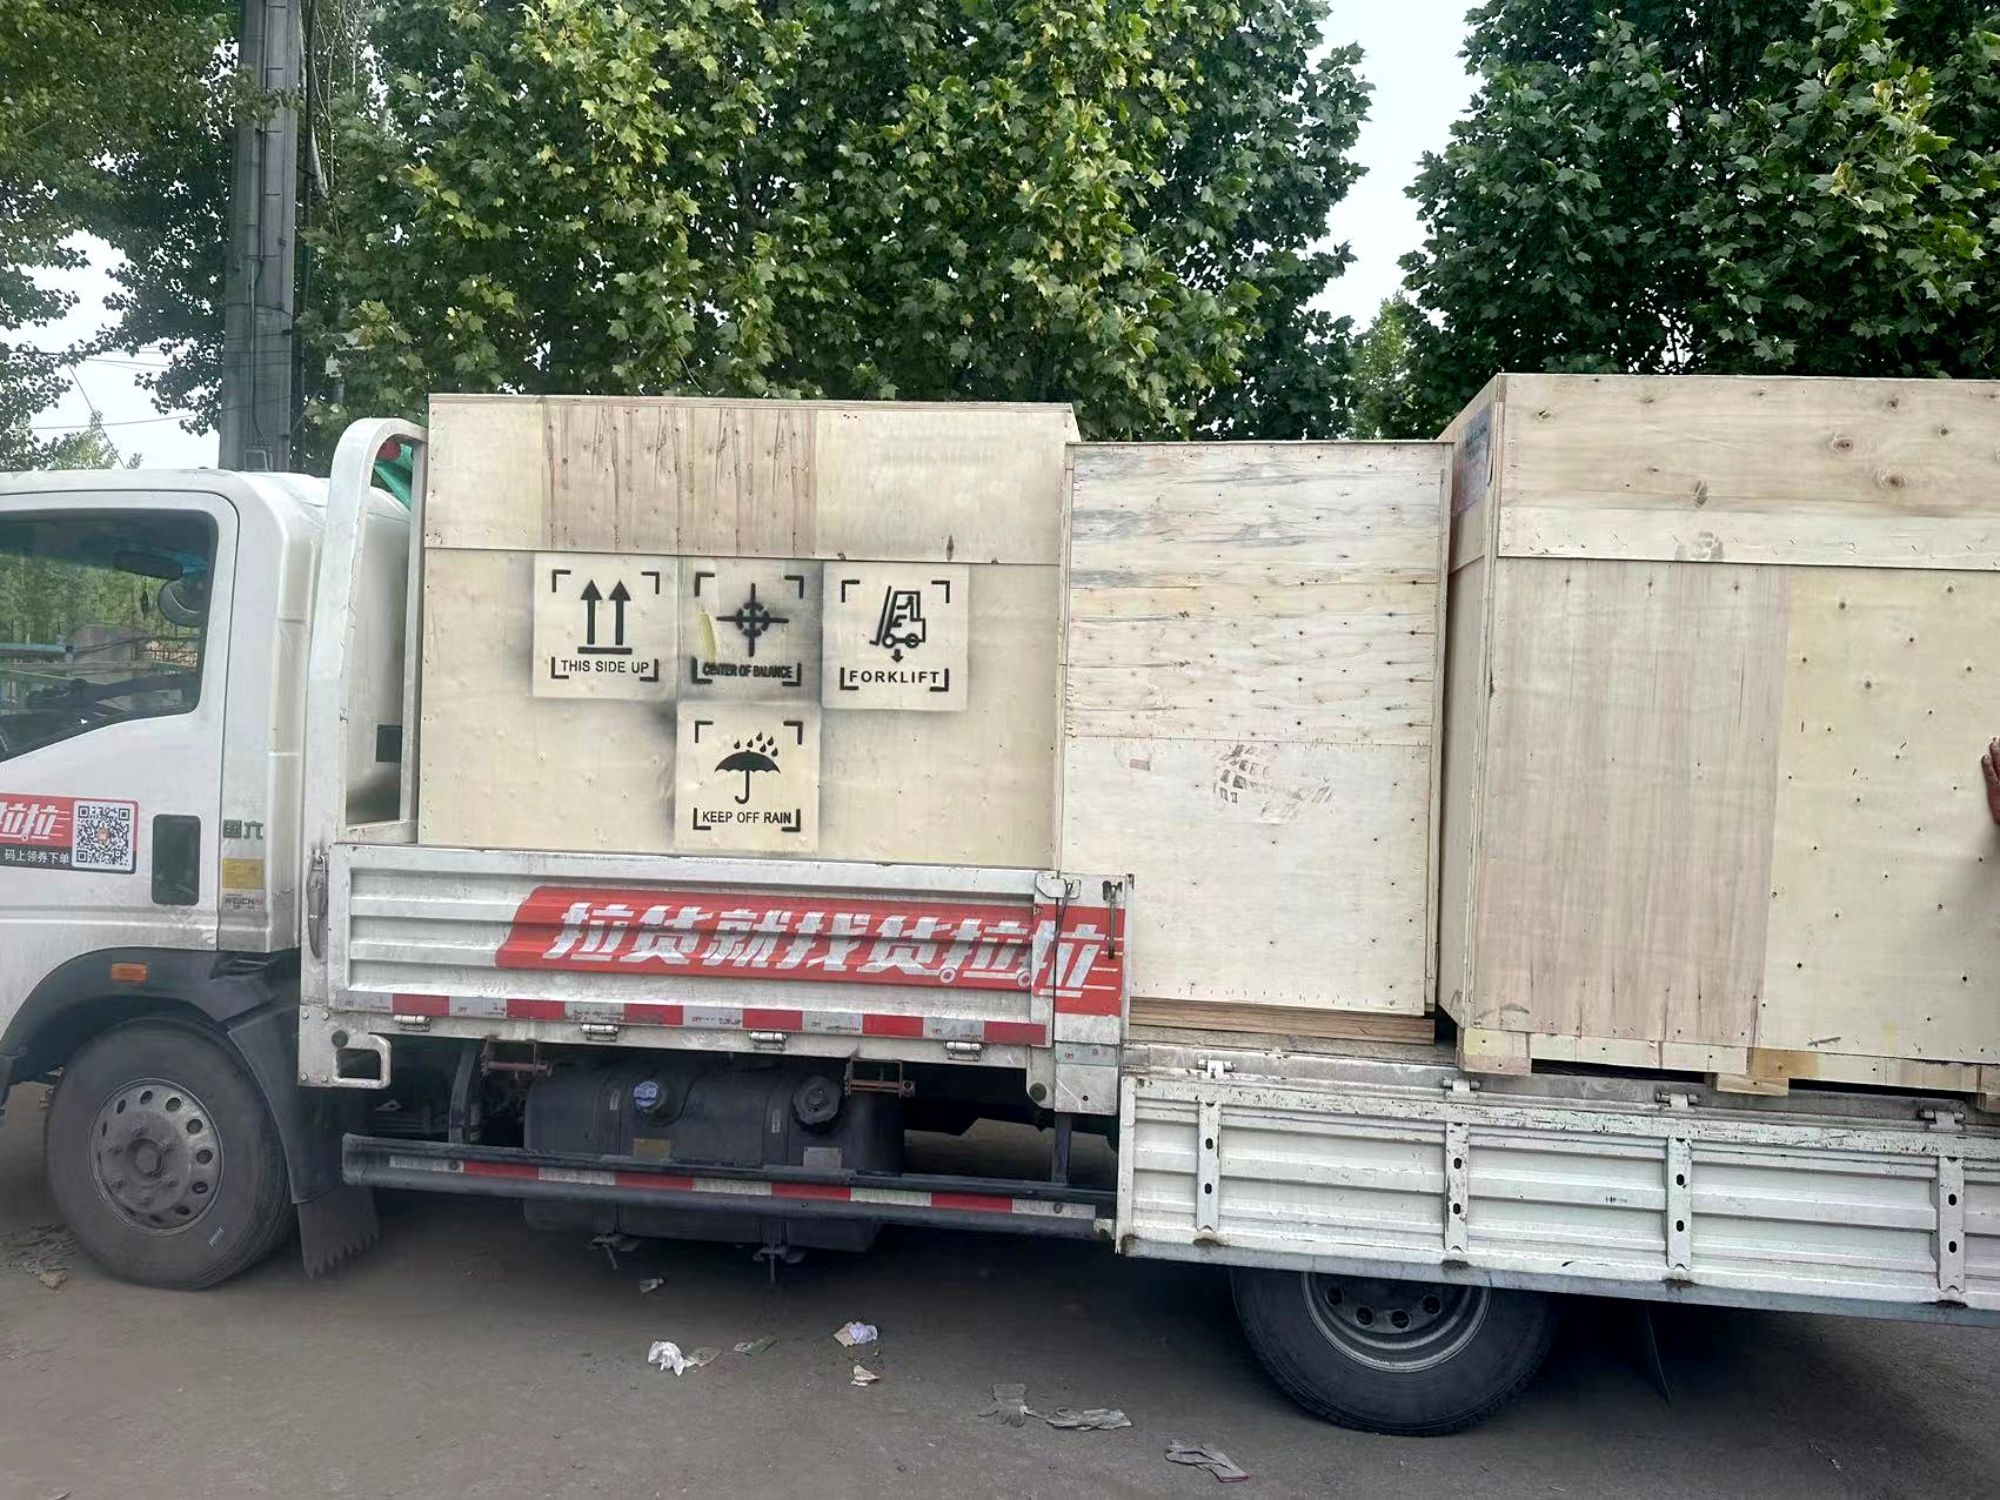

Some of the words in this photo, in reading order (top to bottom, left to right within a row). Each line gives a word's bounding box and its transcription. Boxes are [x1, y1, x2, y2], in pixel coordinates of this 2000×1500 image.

[560, 660, 591, 672] THIS
[595, 661, 626, 673] SIDE
[631, 661, 650, 674] UP
[703, 662, 737, 677] CENTER
[738, 664, 752, 677] OF
[753, 665, 793, 679] BALANCE
[849, 670, 940, 684] FORKLIFT
[702, 811, 733, 823] KEEP
[736, 811, 760, 824] OFF
[763, 812, 792, 824] RAIN
[223, 819, 264, 840] 国六
